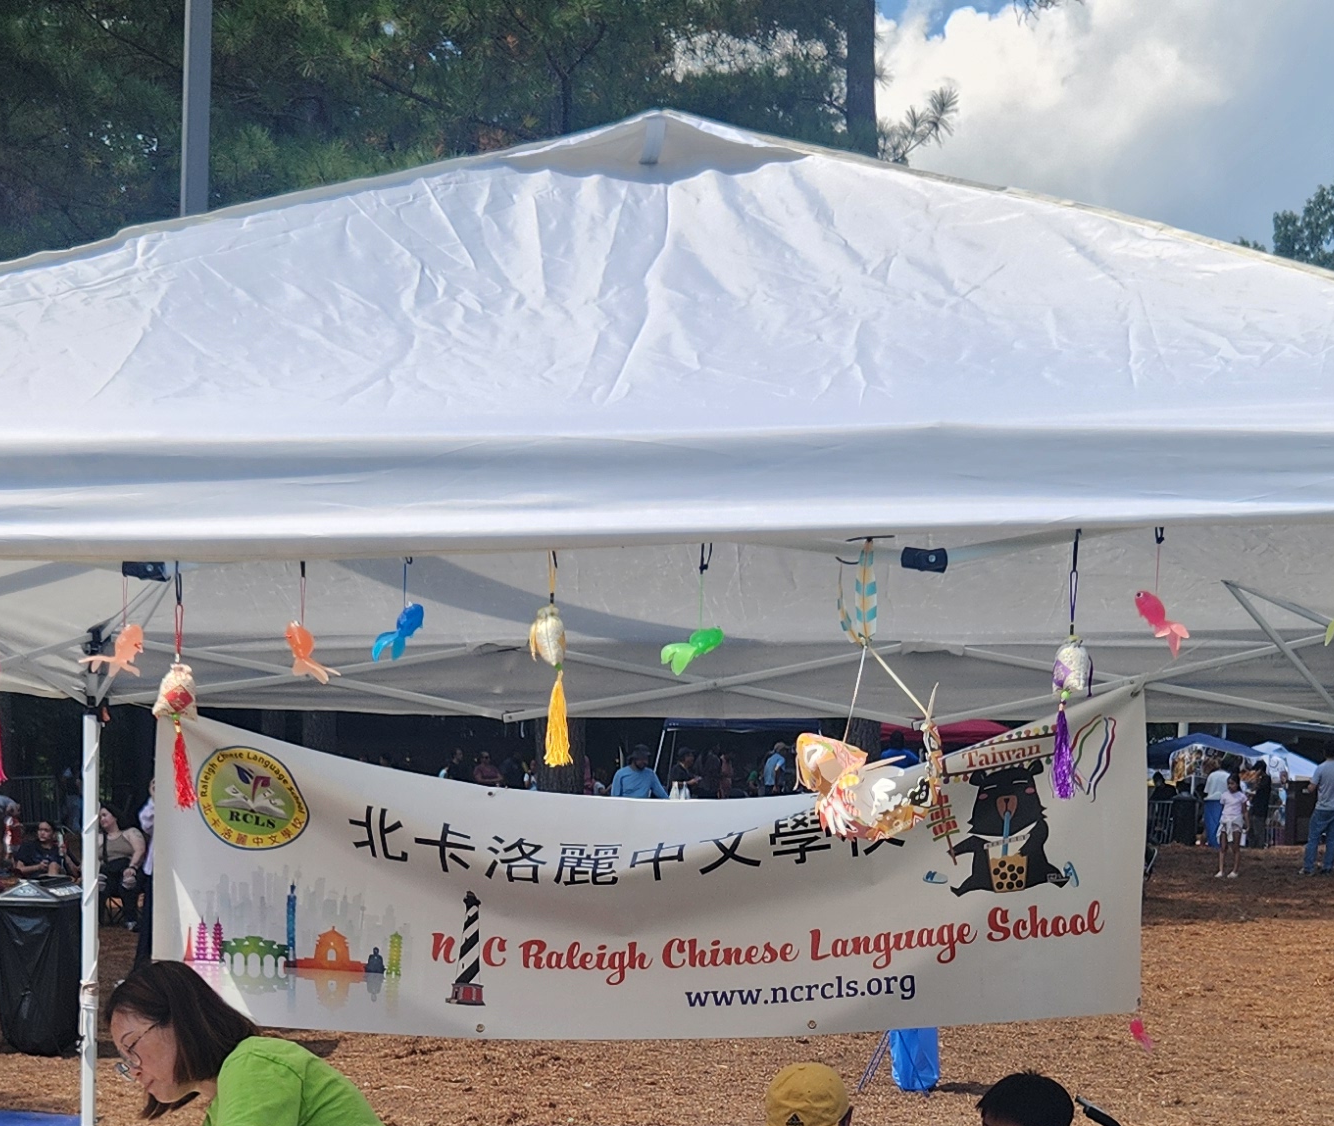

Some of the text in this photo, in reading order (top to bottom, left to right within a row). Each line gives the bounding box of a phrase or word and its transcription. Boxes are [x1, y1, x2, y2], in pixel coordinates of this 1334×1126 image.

[962, 743, 1041, 769] Taiwan
[200, 762, 218, 798] Raleigh
[247, 752, 289, 785] Language
[229, 809, 277, 829] RCLS
[519, 938, 653, 986] Raleigh
[662, 937, 800, 968] Chinese
[809, 922, 977, 969] Language
[986, 900, 1106, 942] School
[685, 973, 917, 1006] www.ncrcls.org
